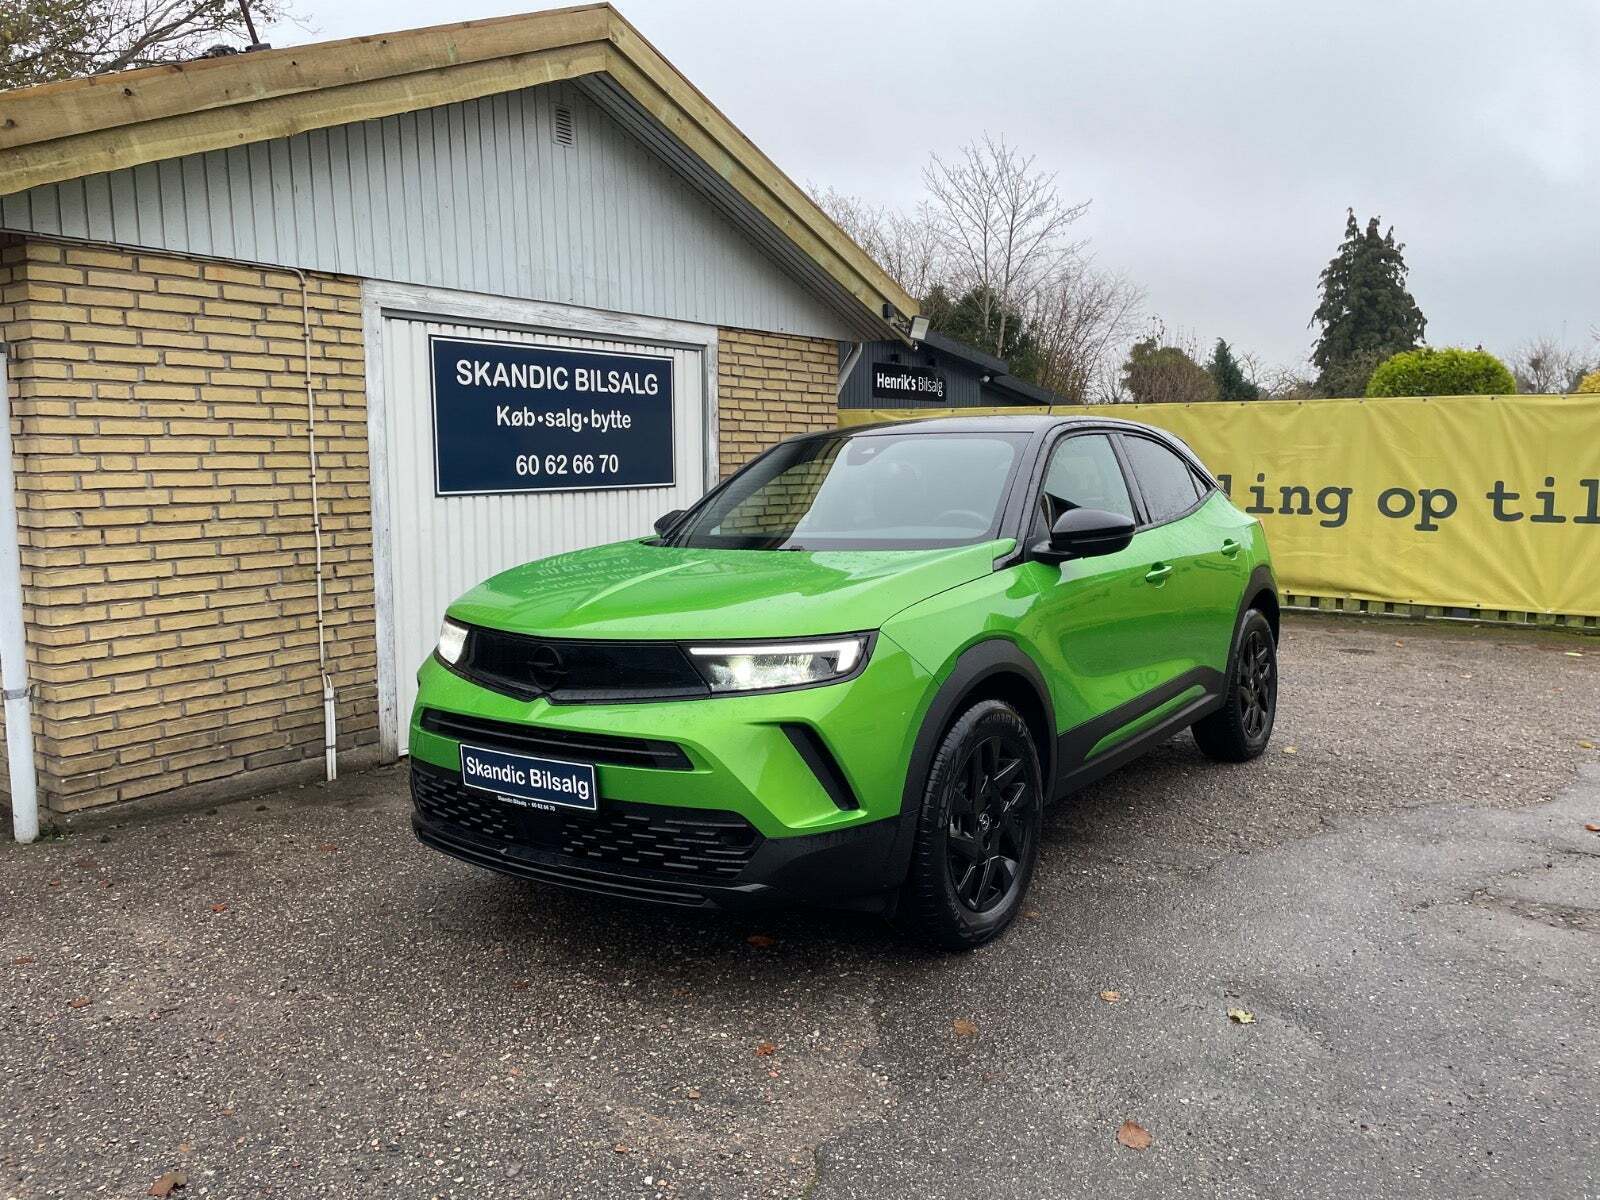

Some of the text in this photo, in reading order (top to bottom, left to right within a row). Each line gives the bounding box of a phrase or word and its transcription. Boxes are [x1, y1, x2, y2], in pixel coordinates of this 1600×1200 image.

[456, 359, 659, 396] SKANDIC BILSALG
[876, 372, 944, 397] Henrik's Bilsalg
[515, 453, 619, 476] 60 62 66 70
[1377, 487, 1458, 532] op
[1485, 476, 1600, 524] til
[466, 756, 589, 799] Skandic Bilsalg
